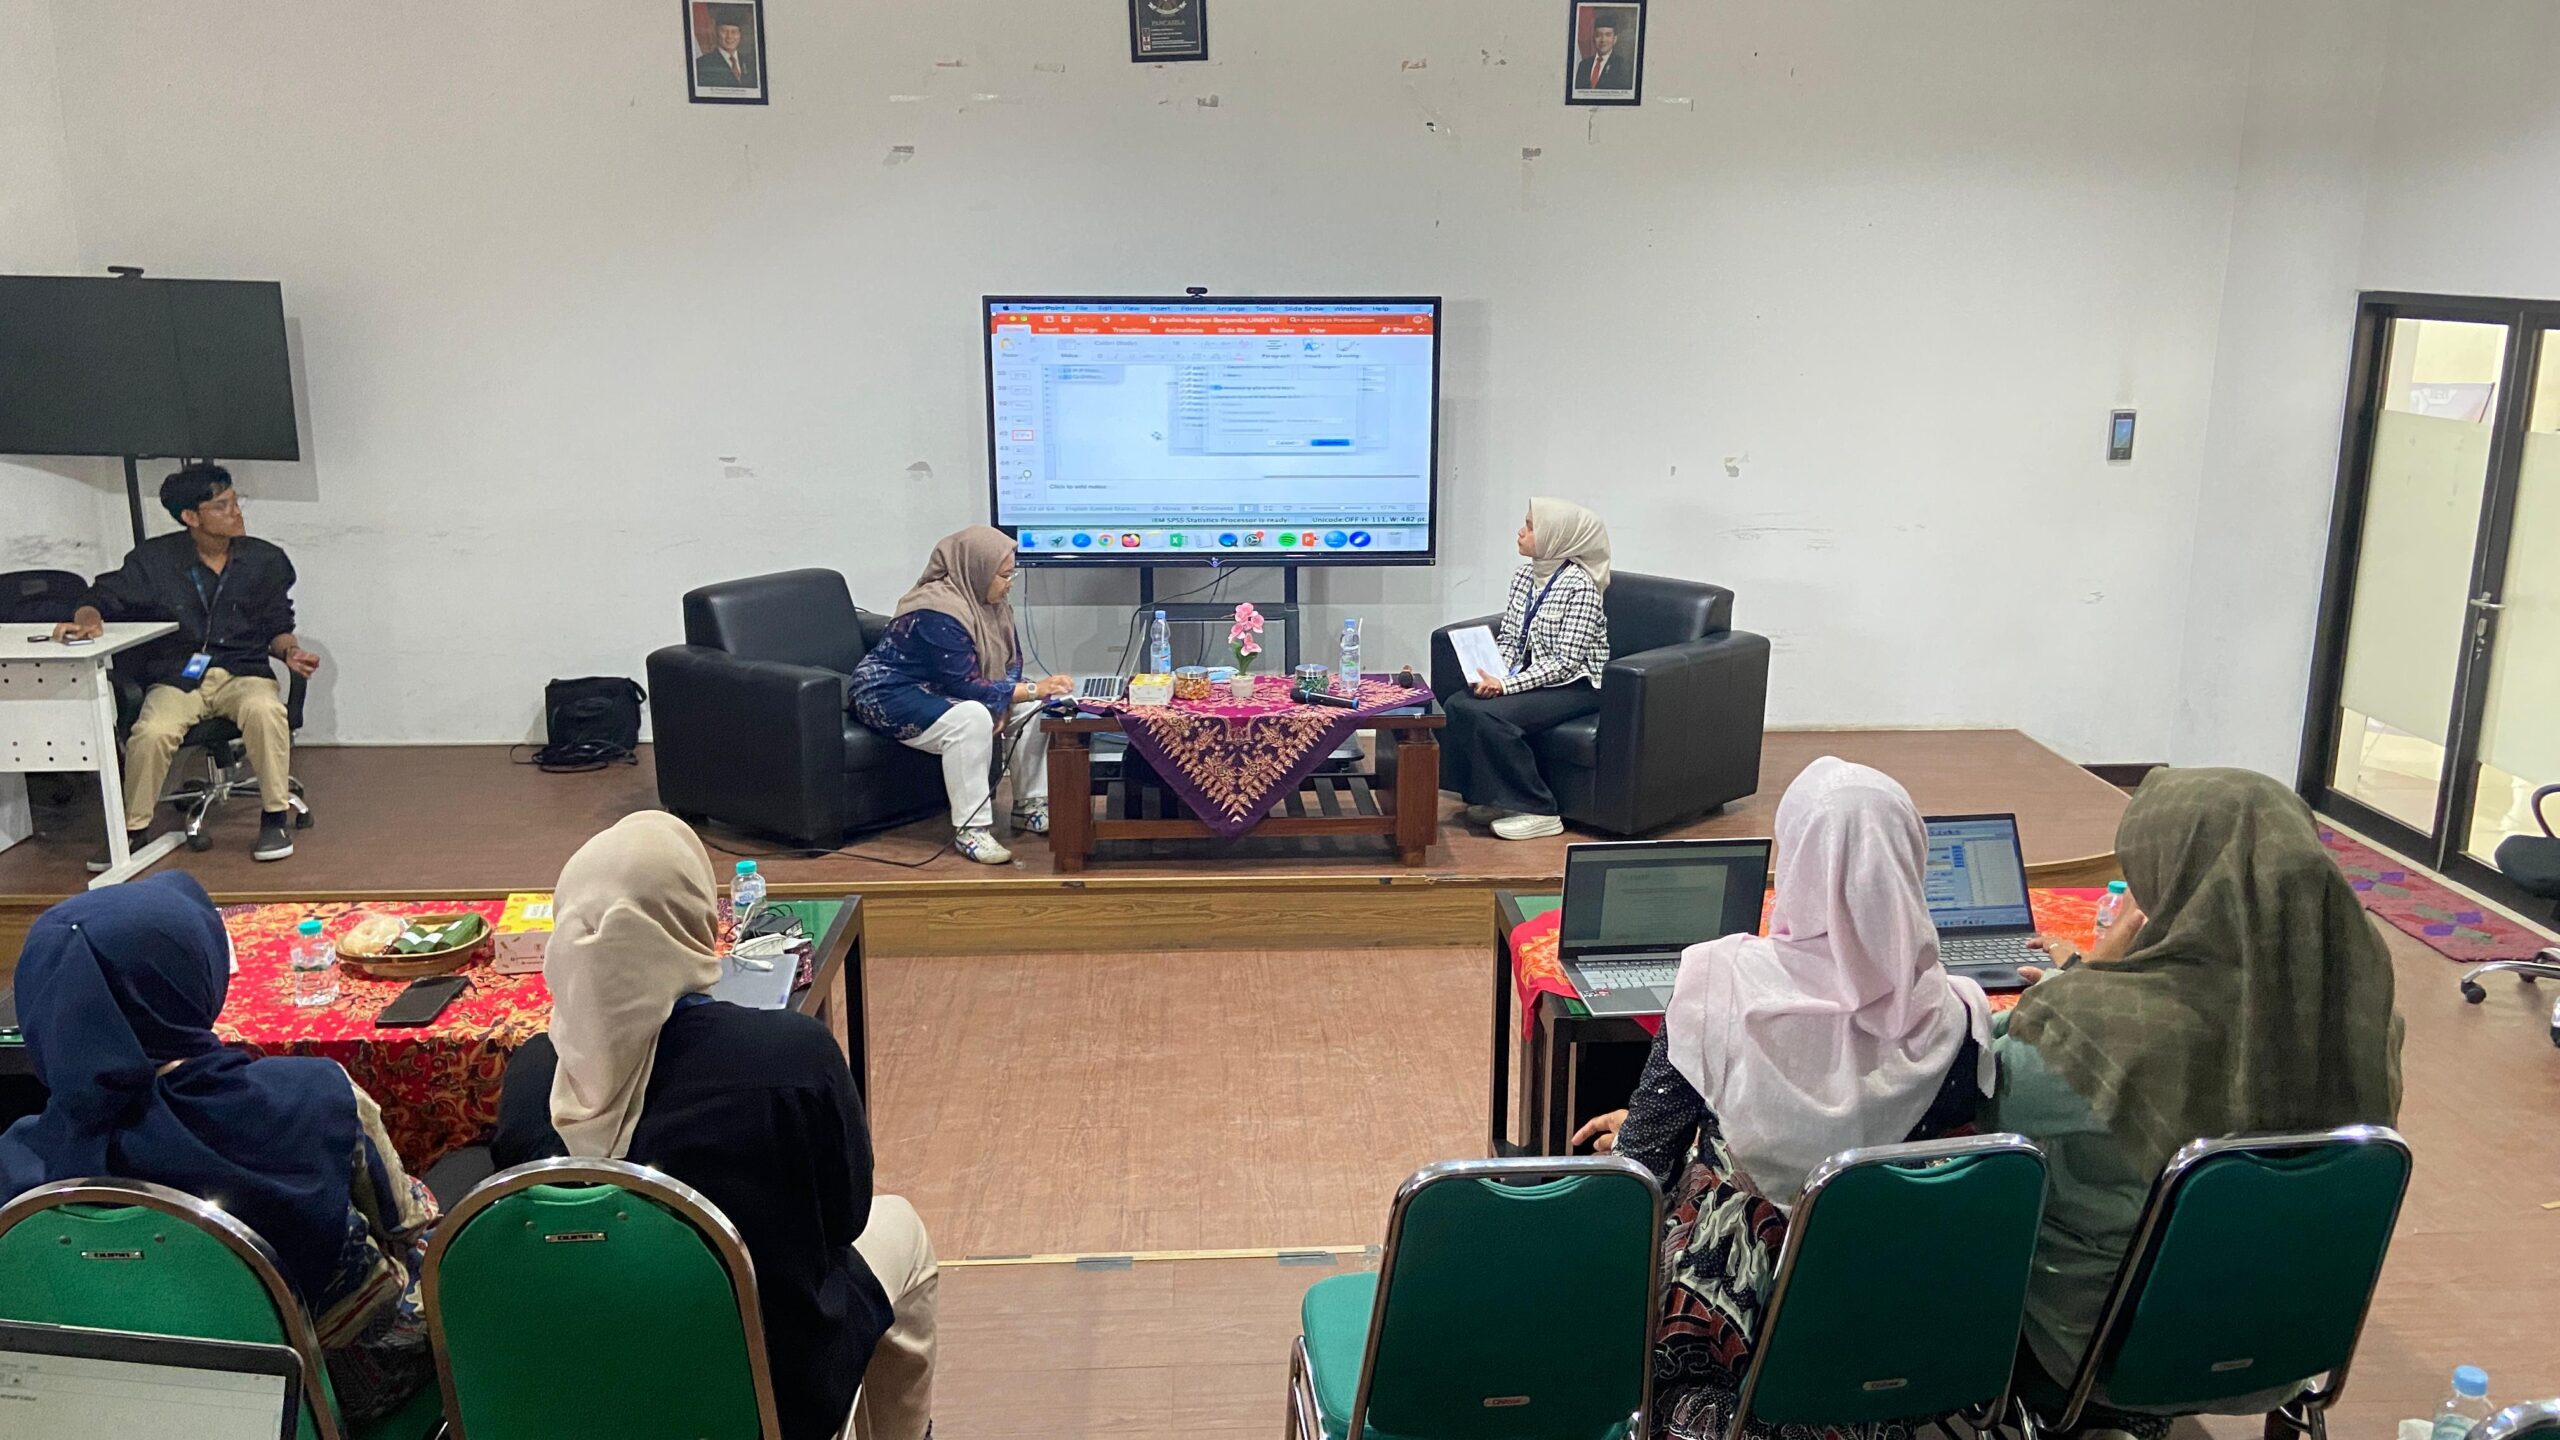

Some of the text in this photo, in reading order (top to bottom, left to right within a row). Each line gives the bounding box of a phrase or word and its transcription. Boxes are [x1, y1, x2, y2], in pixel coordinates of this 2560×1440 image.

[1020, 304, 1065, 312] PowerPoint
[1122, 304, 1140, 312] View
[1216, 305, 1245, 314] Arrange
[1372, 305, 1389, 314] Help
[1073, 327, 1099, 335] Design
[1267, 517, 1288, 525] ready
